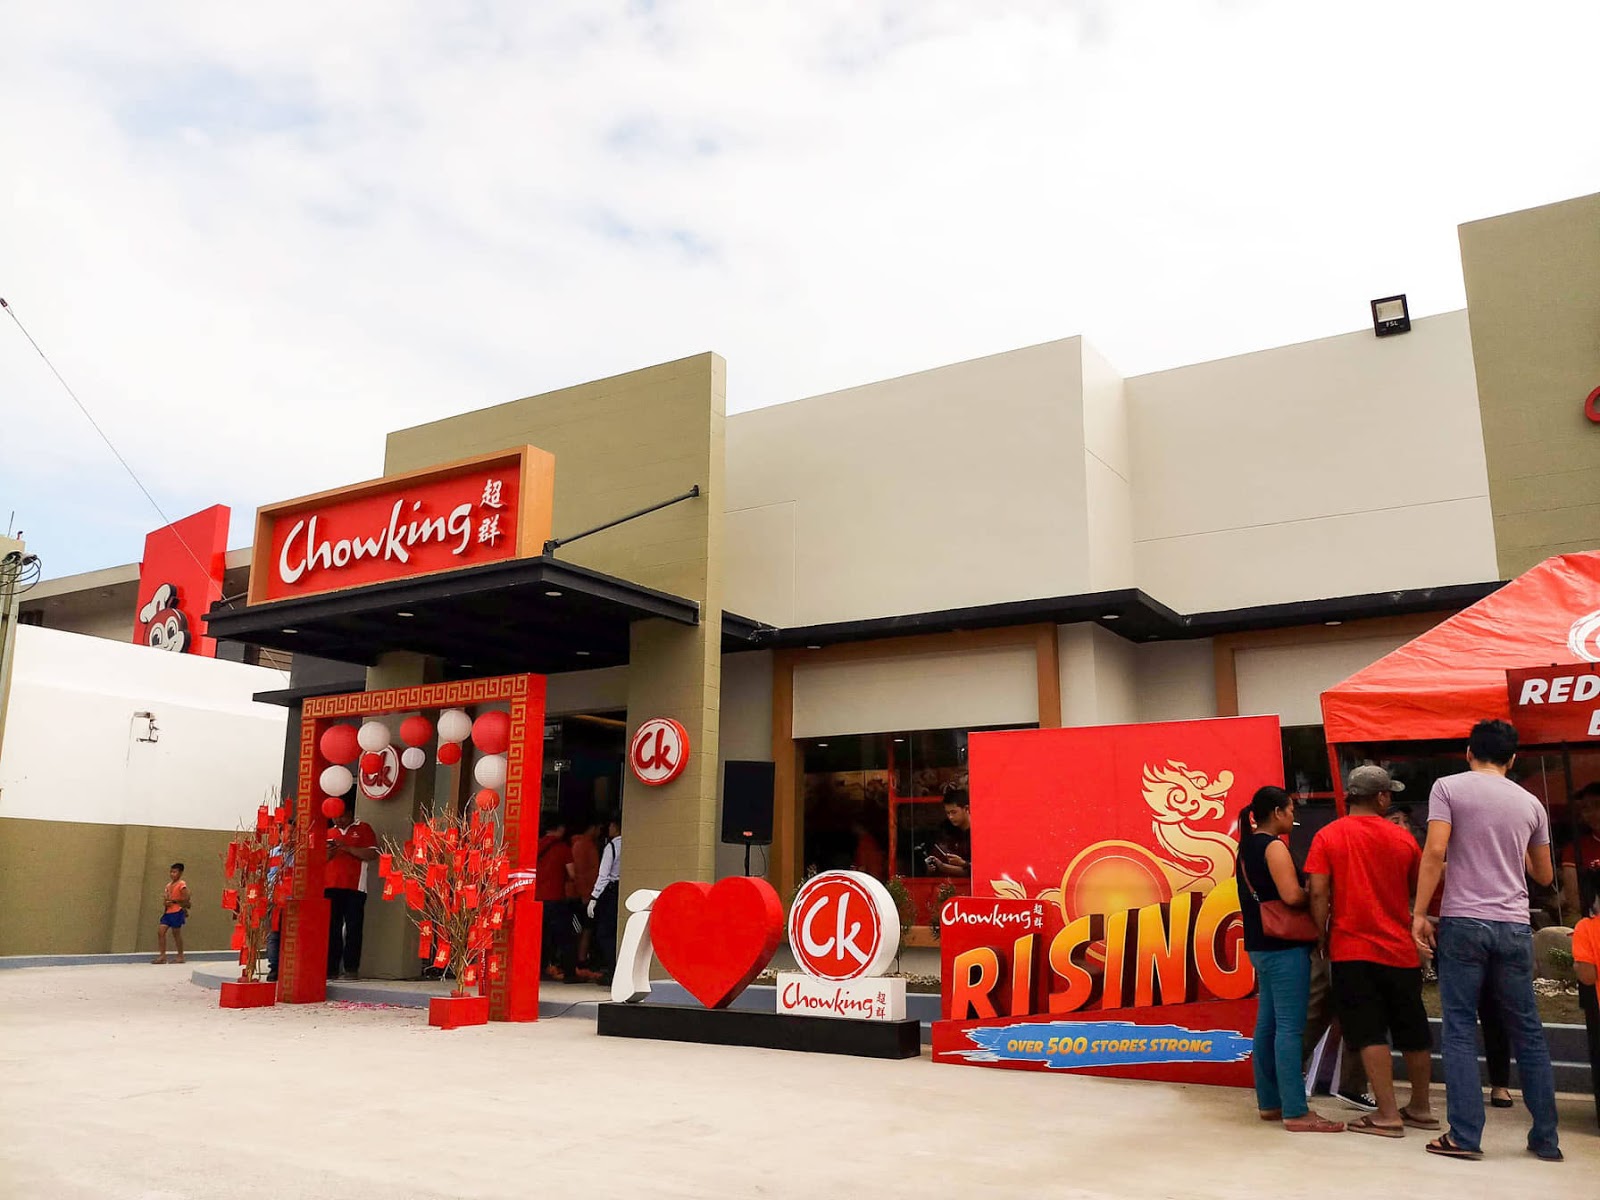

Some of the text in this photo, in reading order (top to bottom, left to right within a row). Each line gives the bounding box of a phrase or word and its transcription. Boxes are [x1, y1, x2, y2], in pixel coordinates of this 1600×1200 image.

[279, 499, 473, 584] Chowking
[1518, 674, 1600, 706] RED
[636, 728, 676, 770] Ck
[802, 892, 870, 966] Ck
[941, 901, 1031, 929] Chowking
[951, 877, 1255, 1021] RISING
[782, 982, 874, 1019] Chowking
[1007, 1036, 1213, 1054] OVER 500 STORES STRONG
